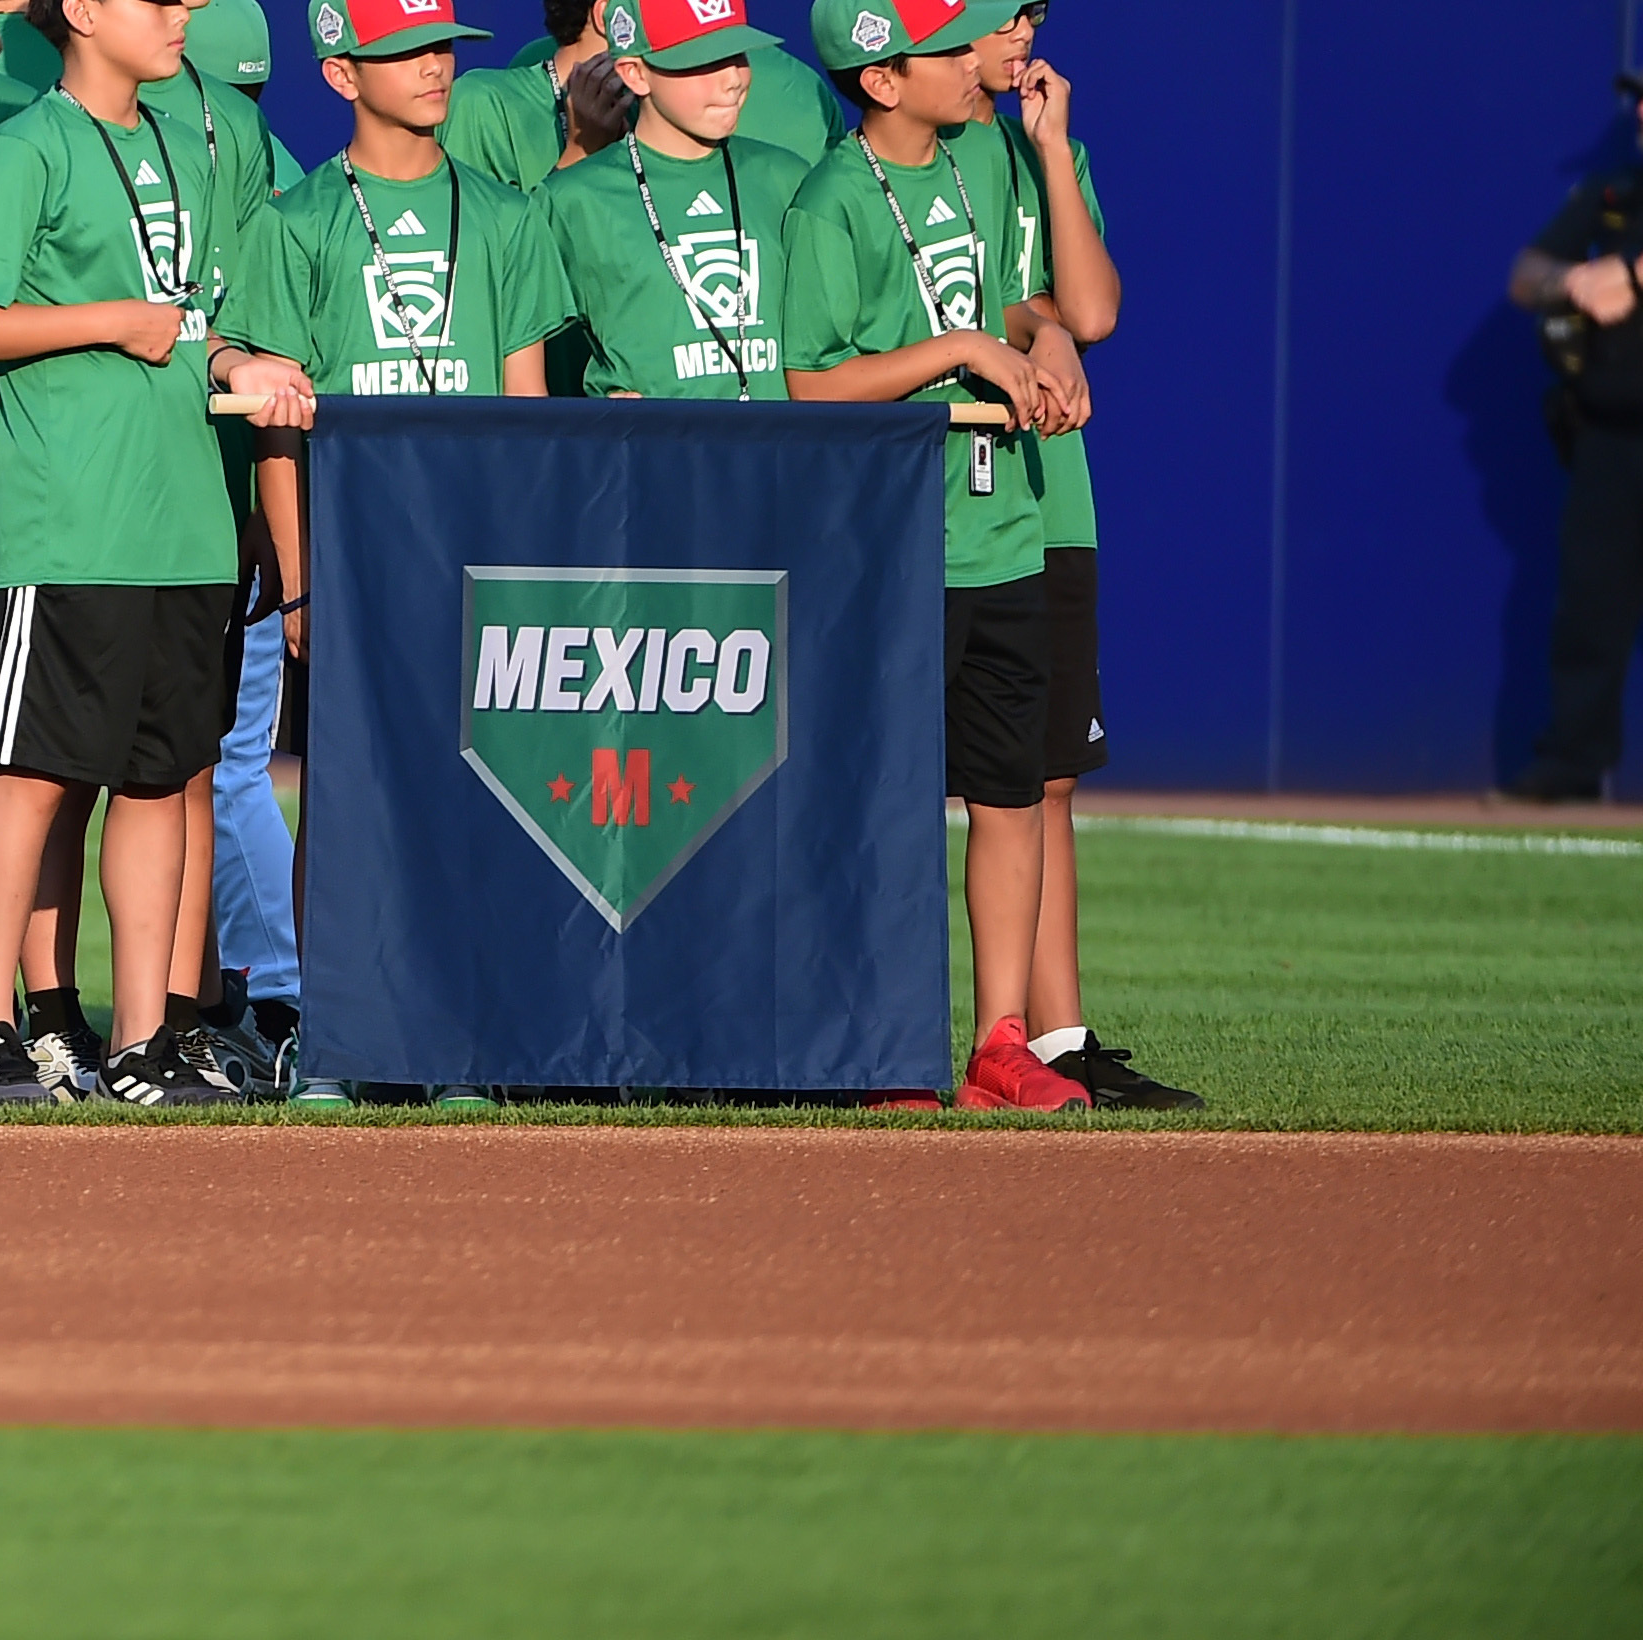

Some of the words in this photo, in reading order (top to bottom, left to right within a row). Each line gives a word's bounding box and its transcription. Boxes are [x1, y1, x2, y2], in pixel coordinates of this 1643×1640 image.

[860, 138, 876, 163] LEAGUE
[872, 162, 885, 181] LITTLE
[353, 187, 367, 213] LEAGUE
[639, 183, 650, 201] LITTLE
[645, 200, 659, 226] LEAGUE
[888, 196, 904, 223] LEAGUE
[363, 213, 374, 232] LITTLE
[899, 223, 913, 242] LITTLE
[673, 338, 777, 380] MEXICO
[352, 359, 469, 395] MEXICO
[472, 625, 771, 714] MEXICO
[591, 748, 650, 827] M
